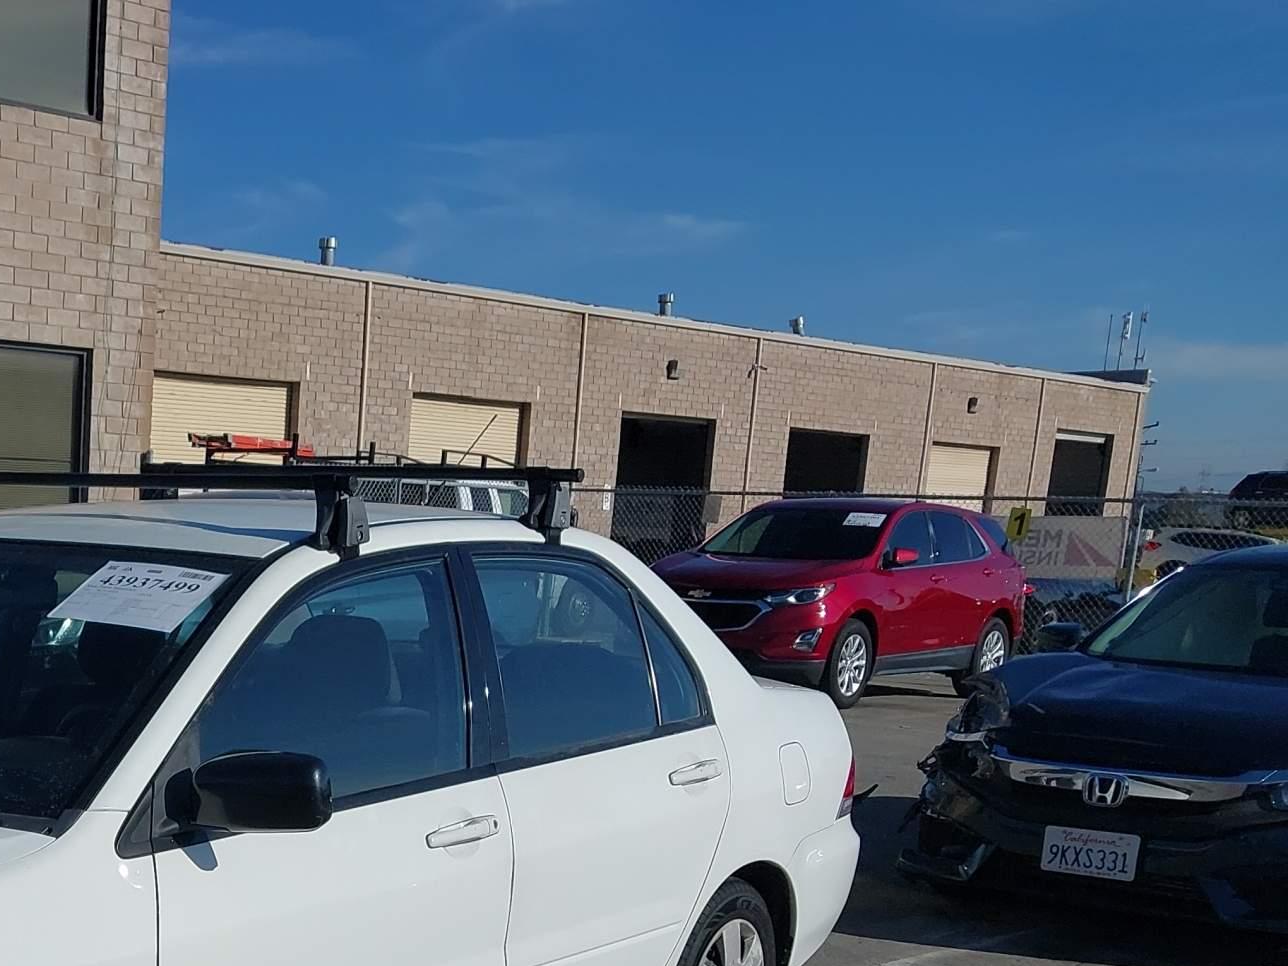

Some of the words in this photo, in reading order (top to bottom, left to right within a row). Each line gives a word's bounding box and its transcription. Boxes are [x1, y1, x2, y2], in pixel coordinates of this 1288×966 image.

[1014, 512, 1027, 536] 1
[100, 574, 201, 594] 43937499
[1063, 830, 1121, 848] California
[1047, 844, 1128, 874] 9KXS331
